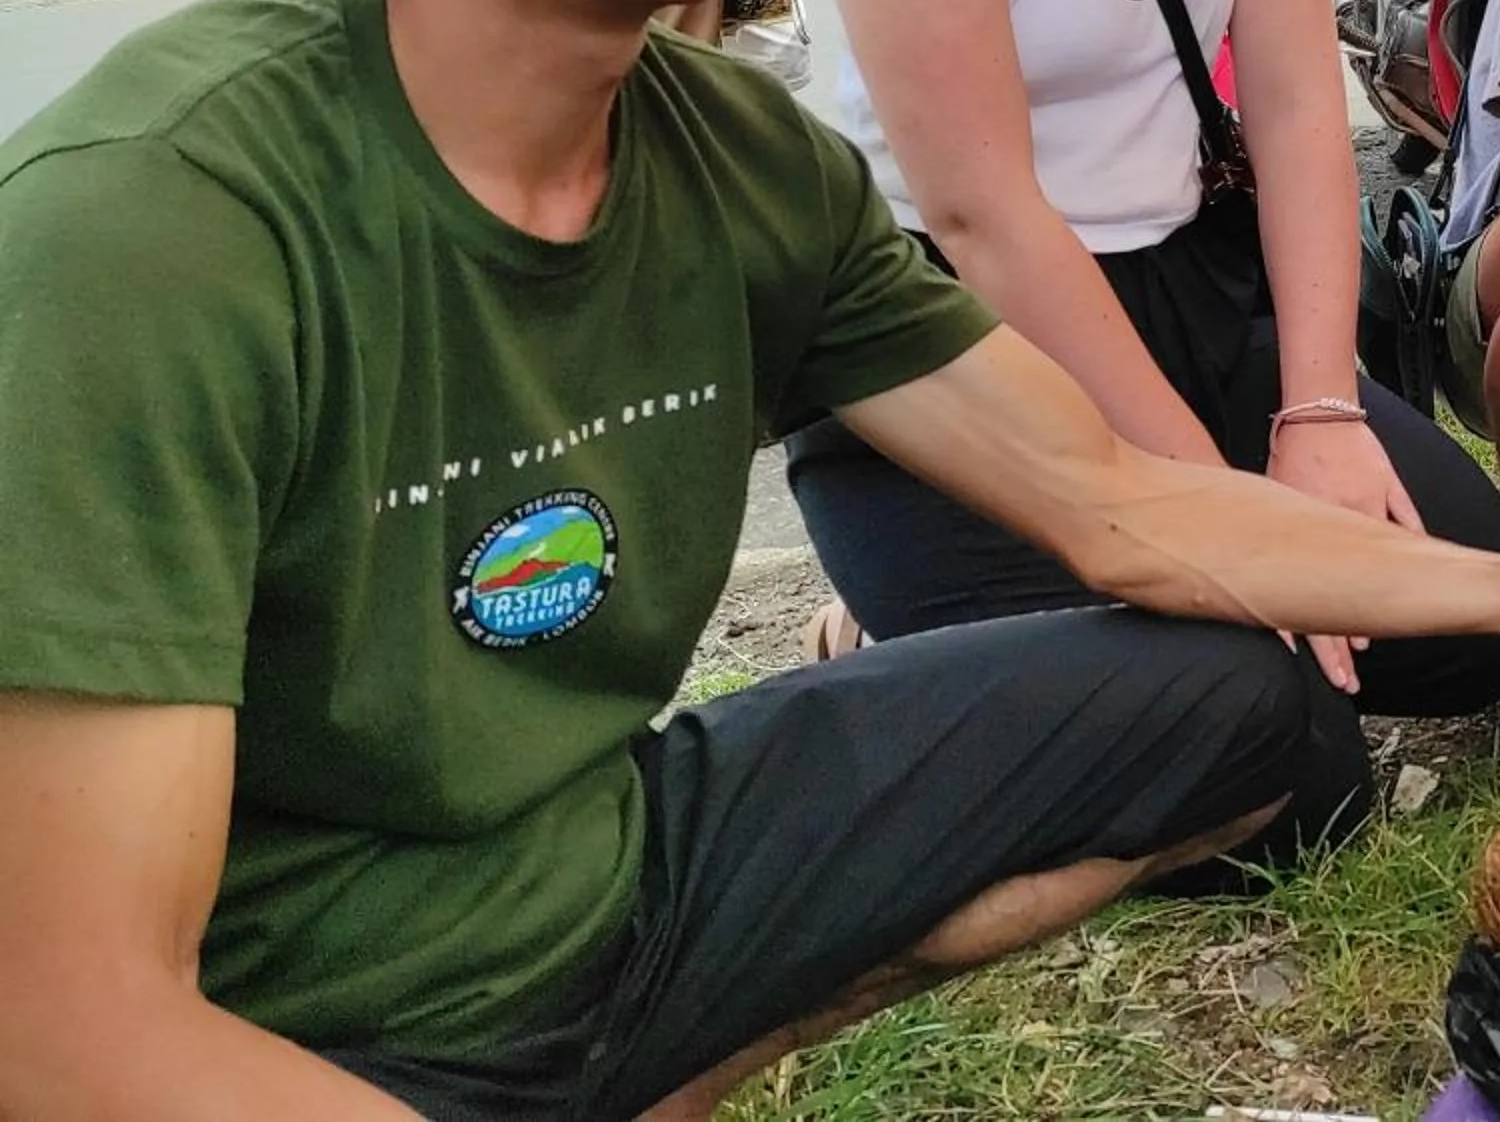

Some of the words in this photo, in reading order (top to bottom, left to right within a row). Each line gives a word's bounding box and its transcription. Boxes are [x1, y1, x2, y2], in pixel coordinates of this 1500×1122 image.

[511, 438, 565, 469] VIA
[622, 383, 717, 425] BERIK
[514, 490, 587, 518] TREKKING
[479, 575, 592, 619] TASTURA
[495, 601, 576, 629] TREKKING
